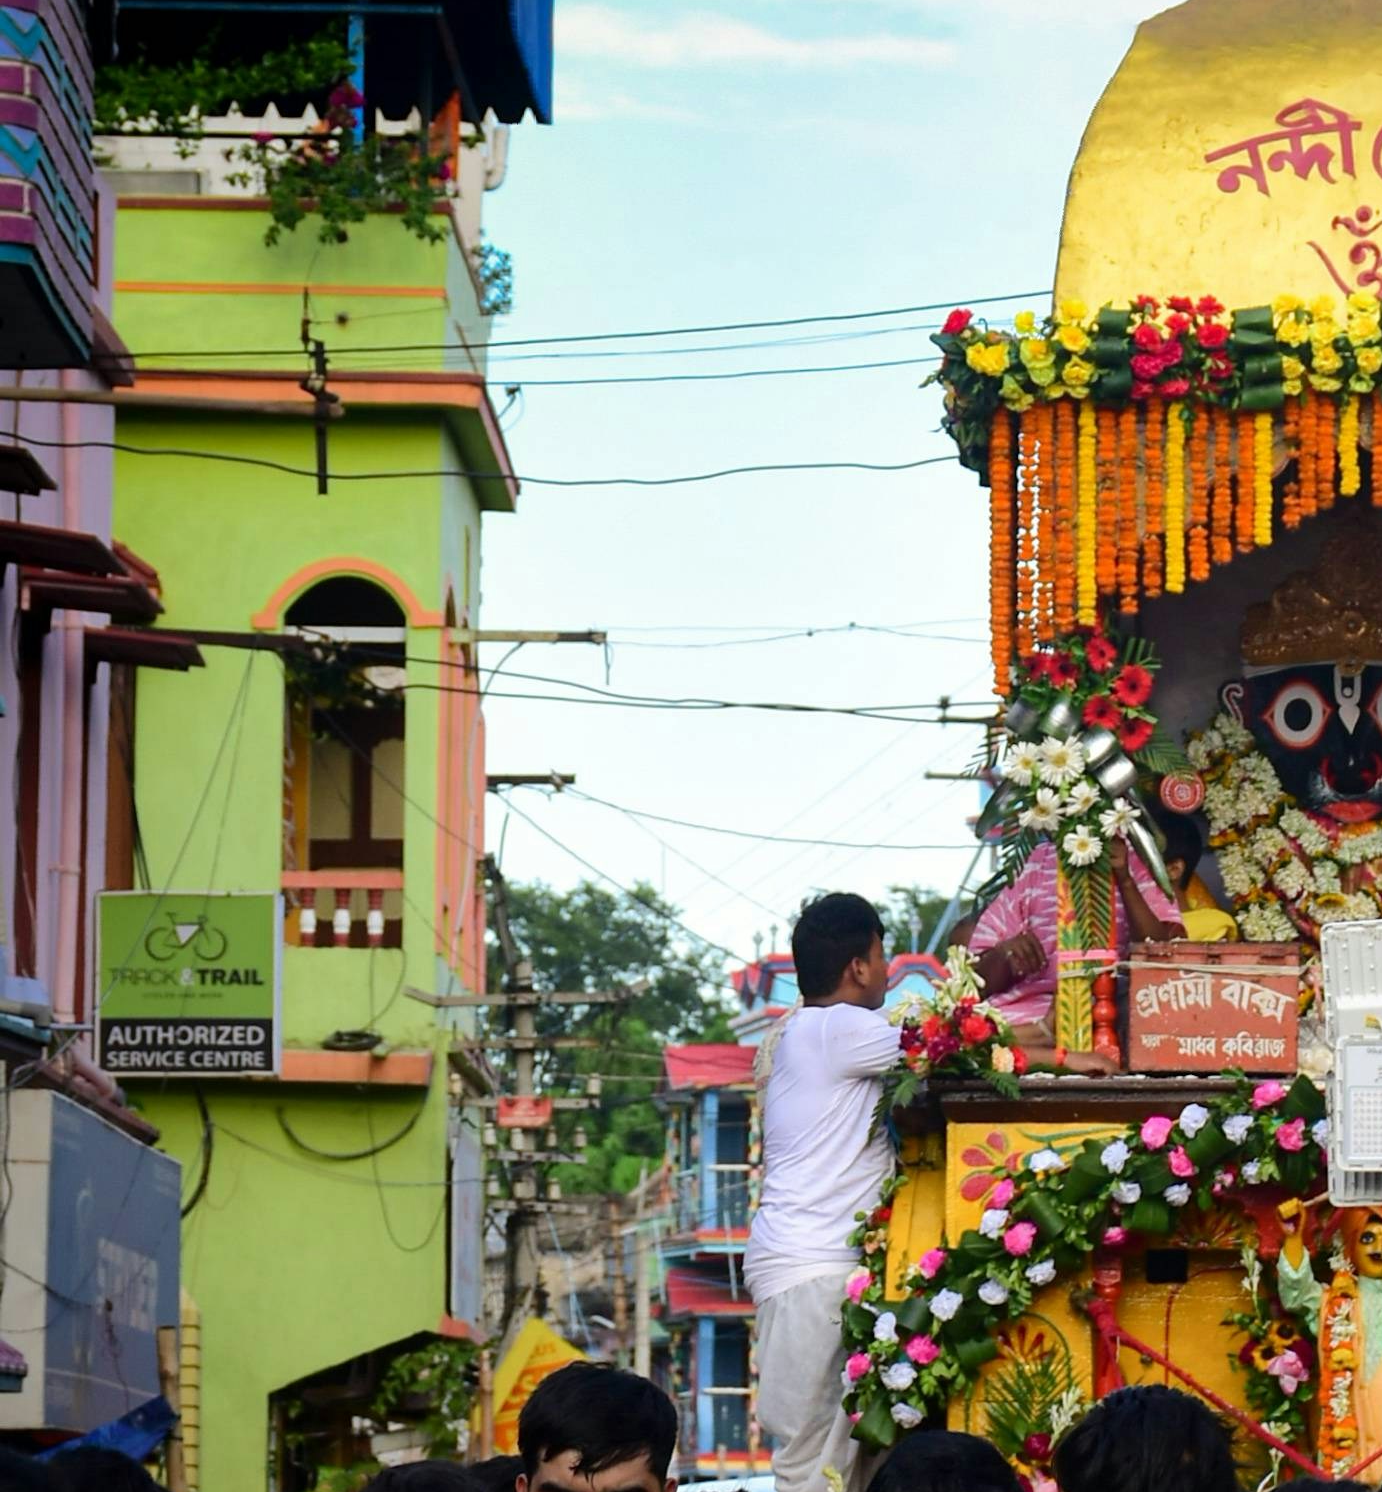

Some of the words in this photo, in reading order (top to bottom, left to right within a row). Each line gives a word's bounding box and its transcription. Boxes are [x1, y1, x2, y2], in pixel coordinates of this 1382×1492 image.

[1204, 98, 1362, 197] নন্দী
[196, 968, 264, 986] TRAIL
[107, 1024, 266, 1046] AUTHORIZED
[106, 1050, 186, 1067] SERVICE
[189, 1050, 266, 1067] CENTRE
